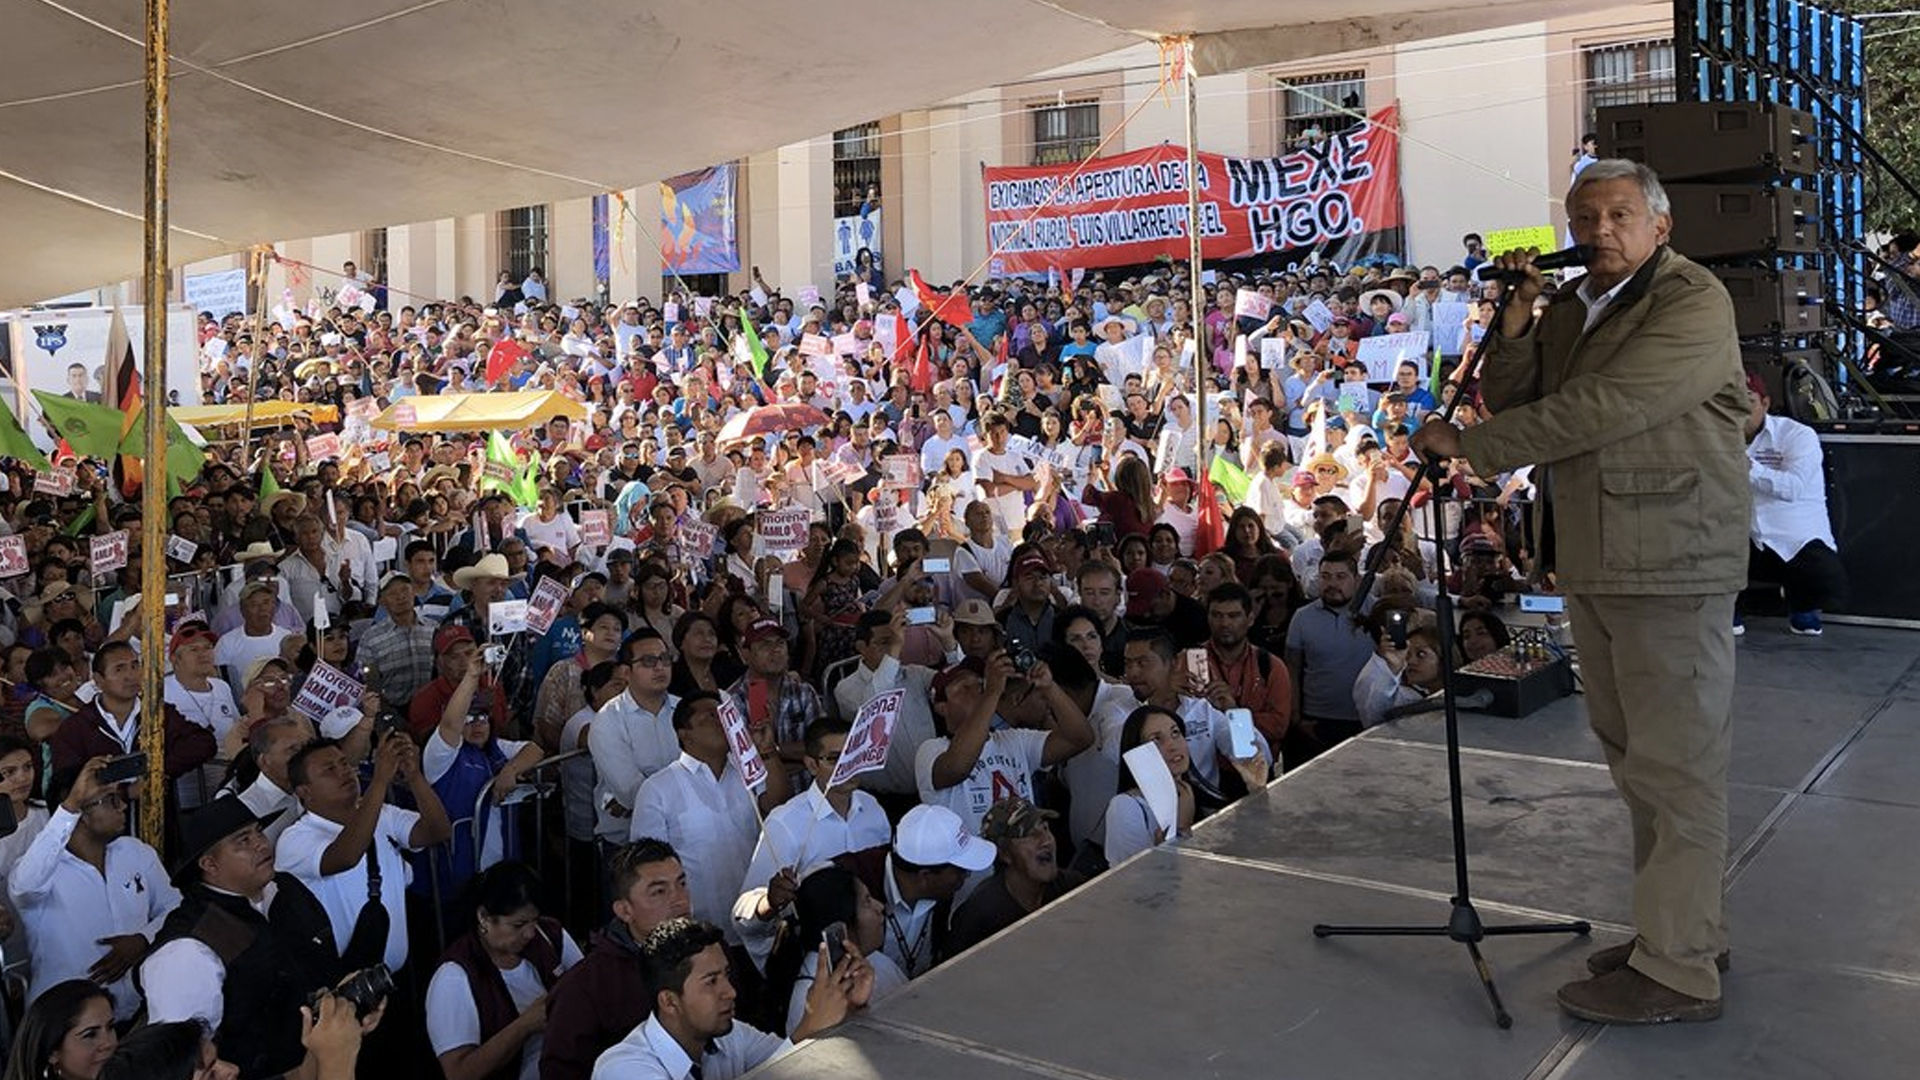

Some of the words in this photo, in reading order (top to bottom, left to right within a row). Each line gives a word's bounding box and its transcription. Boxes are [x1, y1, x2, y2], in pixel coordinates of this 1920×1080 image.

[1226, 121, 1371, 203] MEXE
[990, 178, 1052, 209] EXIGIMOS
[1076, 164, 1158, 201] APERTURA
[1160, 162, 1182, 190] DE
[1035, 219, 1072, 247] RURAL
[1205, 203, 1225, 233] EL
[1251, 192, 1362, 251] HGO.
[763, 513, 809, 525] morena
[763, 526, 791, 537] AMLO
[304, 677, 337, 704] AMLO
[313, 665, 362, 698] morena
